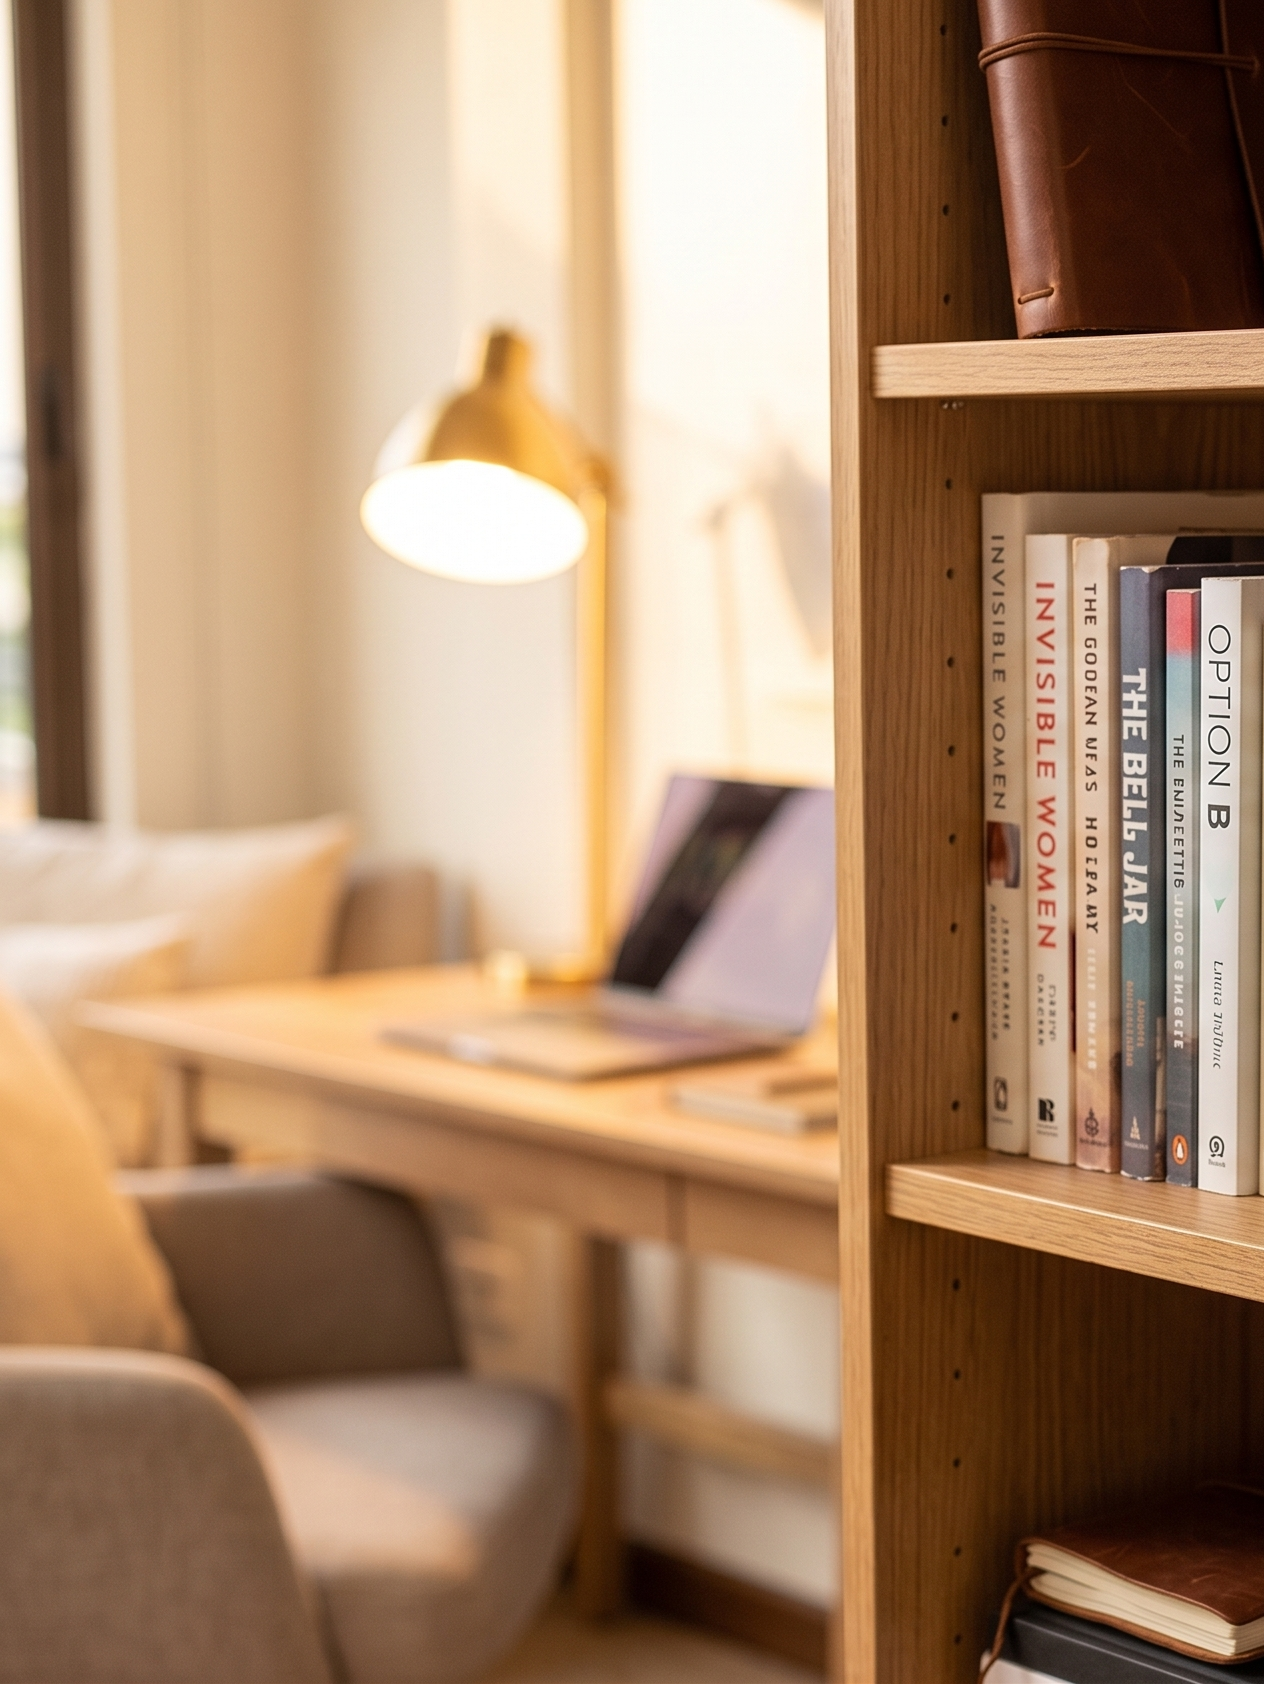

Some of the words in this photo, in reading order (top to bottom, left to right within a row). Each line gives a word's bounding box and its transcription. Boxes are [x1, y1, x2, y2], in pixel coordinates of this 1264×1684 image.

[991, 536, 1005, 682] INVISIBLE
[1085, 584, 1096, 625] THE
[1036, 583, 1055, 778] INVISIBLE
[1122, 668, 1147, 740] THE
[1208, 625, 1231, 786] OPTION
[993, 696, 1006, 809] WOMEN
[1174, 735, 1184, 768] THE
[1123, 752, 1147, 841] BELL
[1208, 804, 1230, 828] B
[1037, 797, 1056, 948] WOMEN
[1123, 852, 1147, 924] JAR
